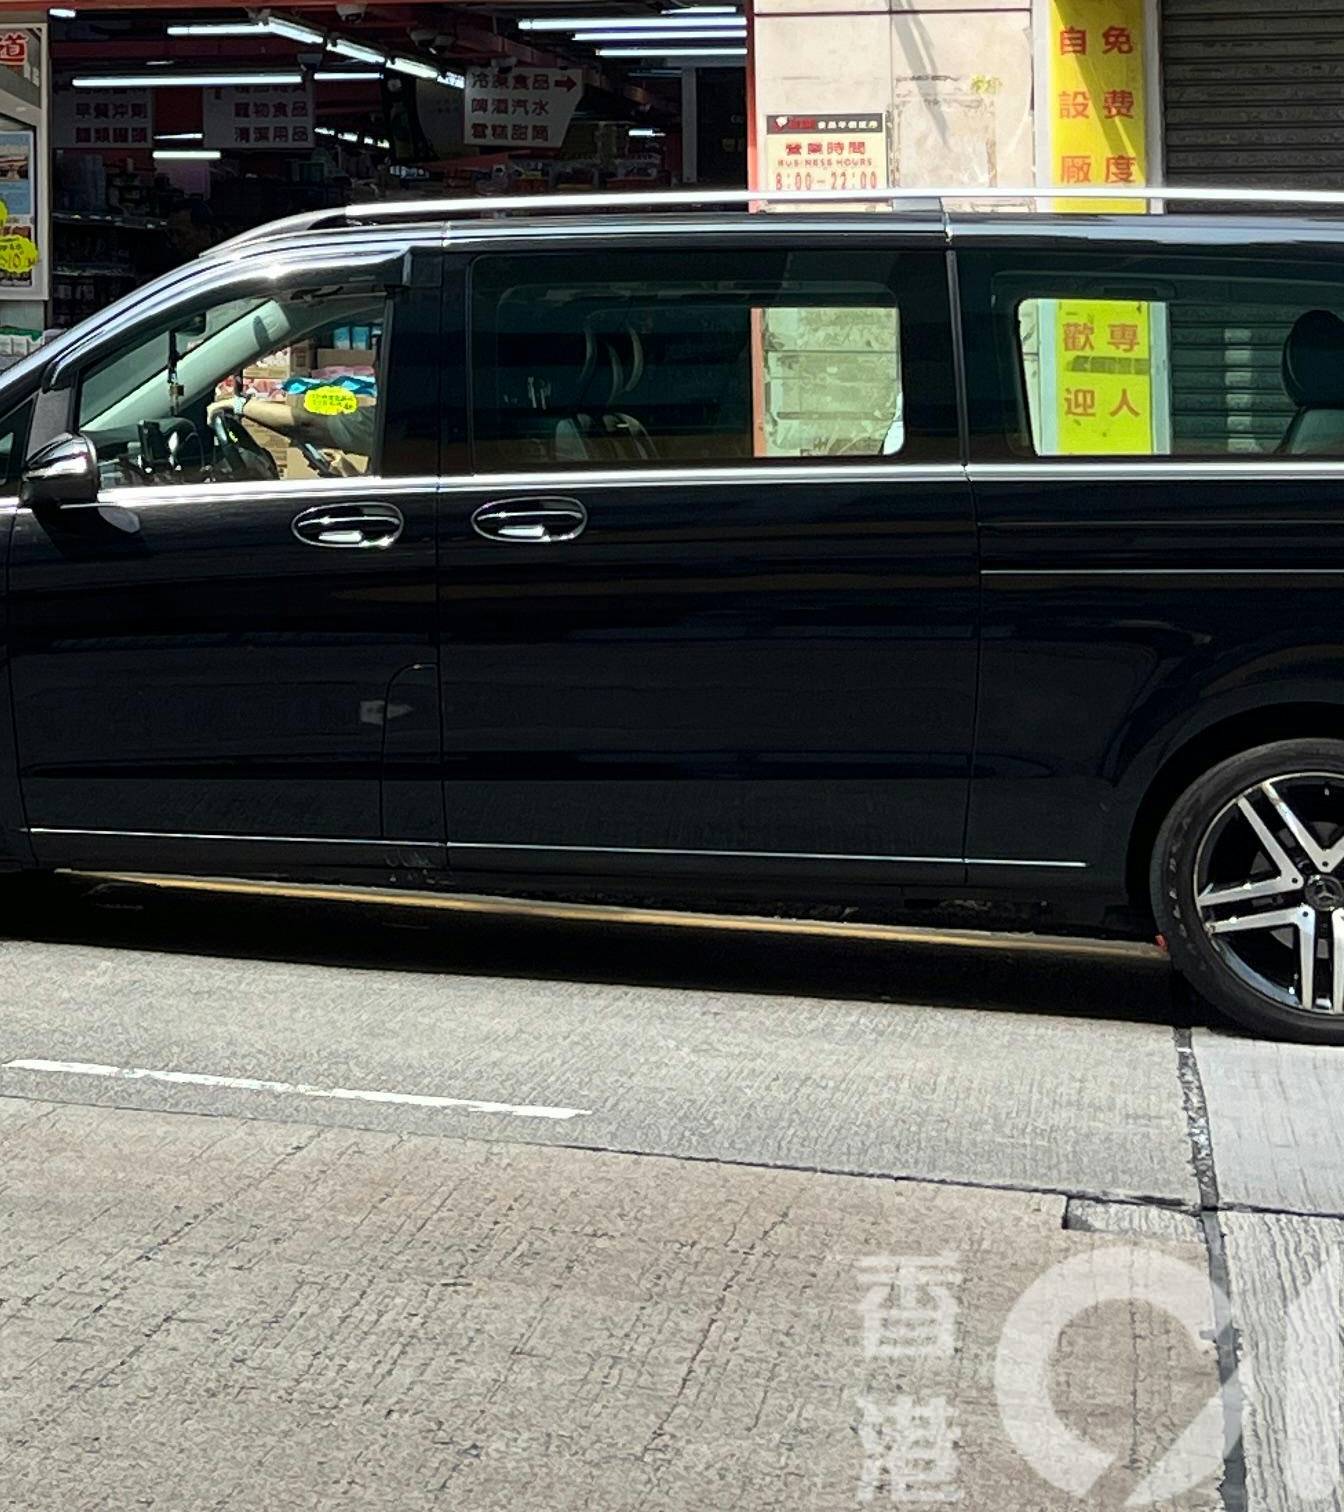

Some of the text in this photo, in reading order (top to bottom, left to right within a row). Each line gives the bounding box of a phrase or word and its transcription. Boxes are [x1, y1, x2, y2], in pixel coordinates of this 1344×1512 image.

[472, 73, 551, 91] 冷凍食品
[472, 98, 551, 115] 啤酒汽水
[786, 142, 867, 156] 營業時間
[777, 158, 873, 168] BUSINESS HOURS
